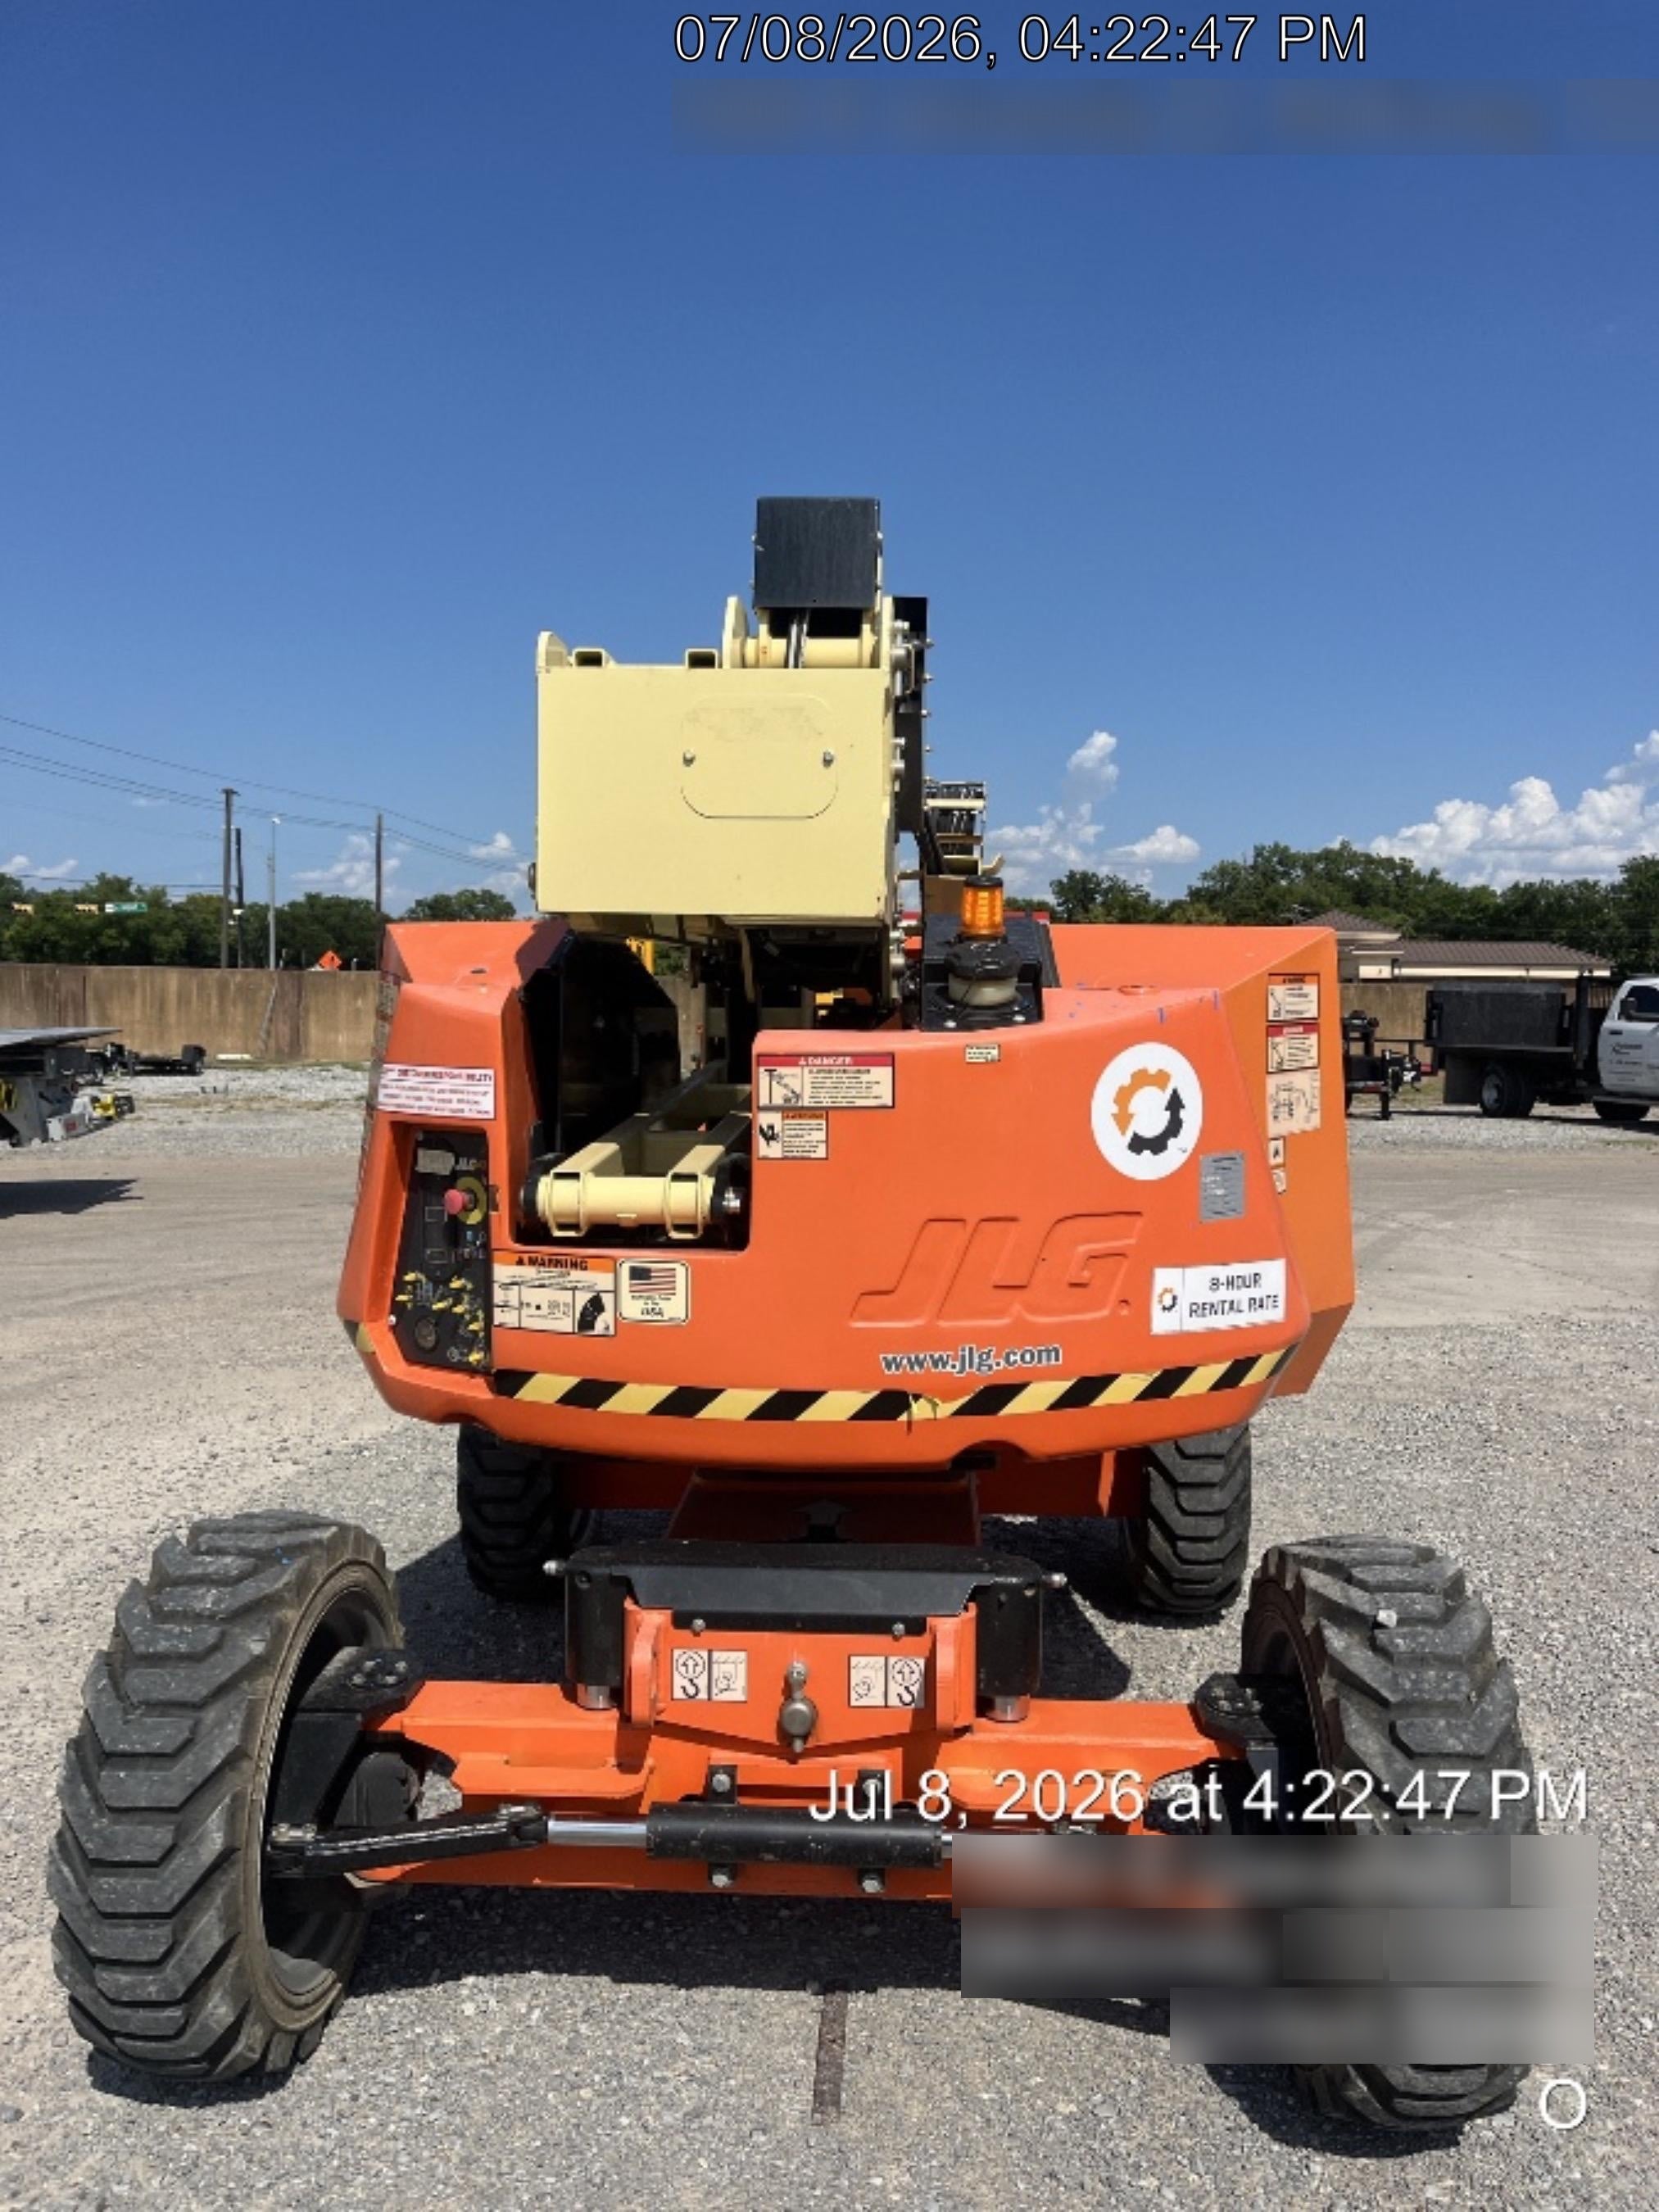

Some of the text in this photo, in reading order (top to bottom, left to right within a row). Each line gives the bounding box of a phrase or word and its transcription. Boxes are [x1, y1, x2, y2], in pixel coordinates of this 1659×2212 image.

[528, 1256, 589, 1271] WARNING
[850, 1212, 1143, 1328] JLG
[1189, 1294, 1280, 1318] RENTAL RATE
[880, 1344, 1063, 1376] www.jlg.com
